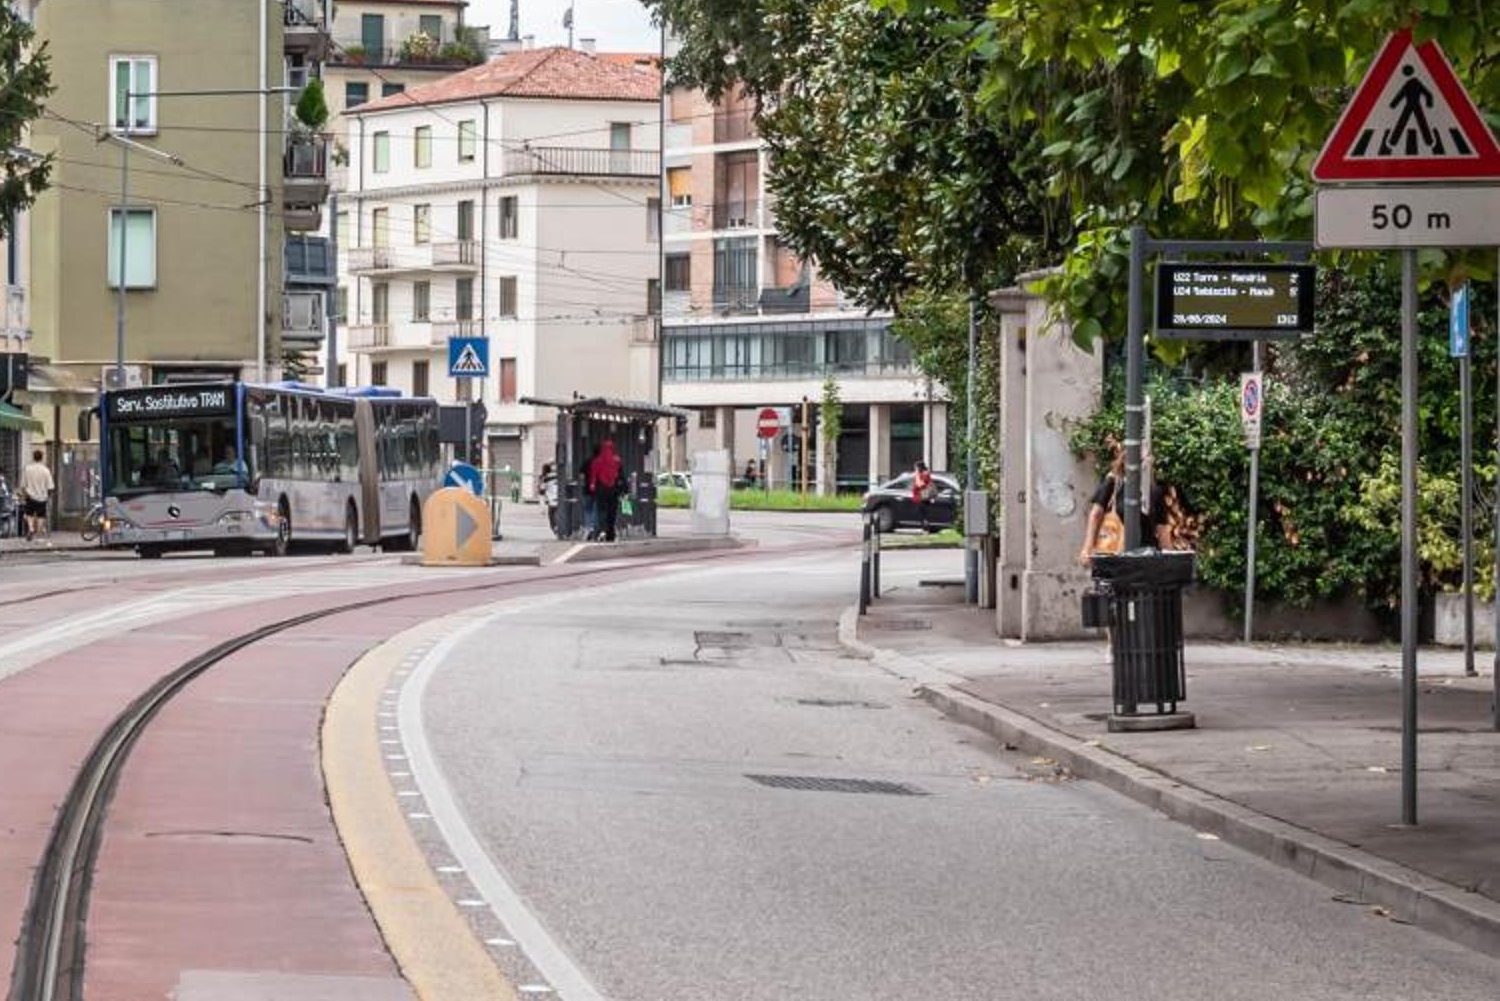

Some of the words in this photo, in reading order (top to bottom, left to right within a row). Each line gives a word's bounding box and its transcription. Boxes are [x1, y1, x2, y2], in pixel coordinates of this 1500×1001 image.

[1372, 204, 1412, 230] 50
[1428, 212, 1451, 229] m
[117, 397, 144, 412] Serv.
[145, 393, 198, 409] Sostitutivo
[200, 391, 225, 407] TRAM
